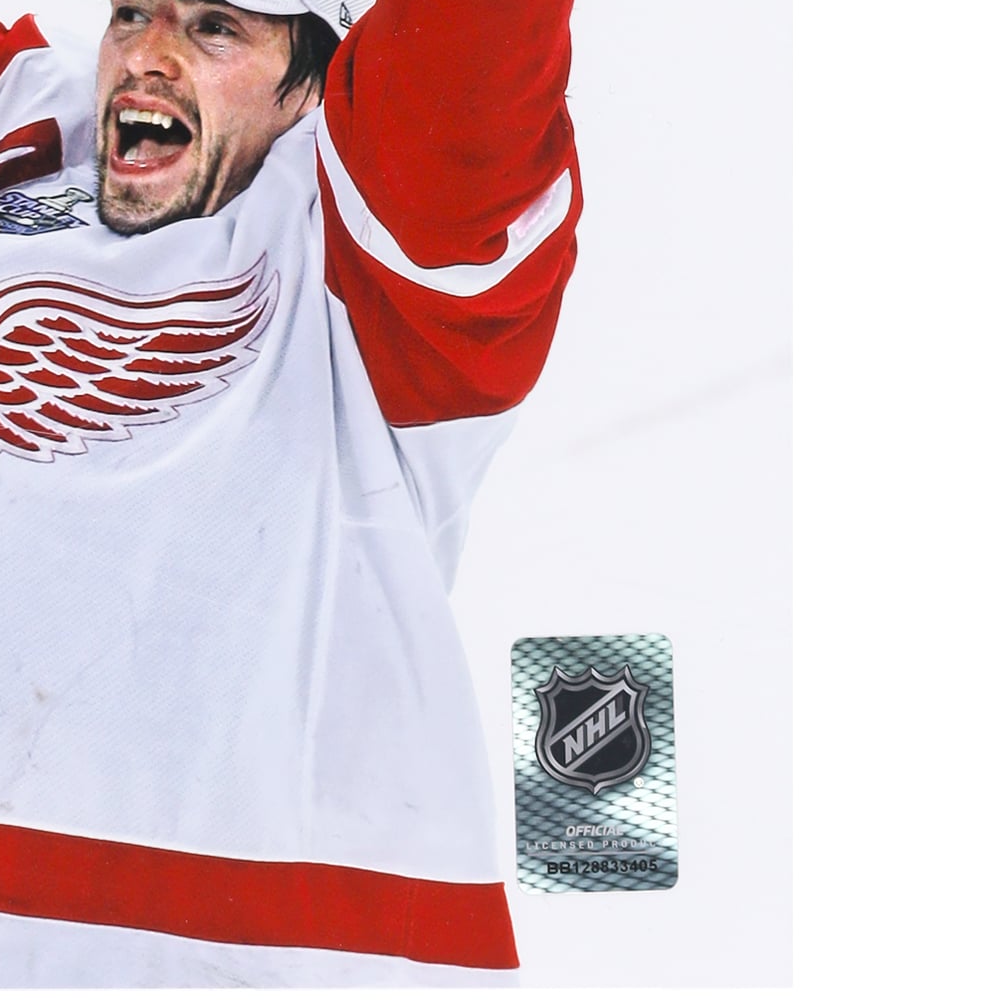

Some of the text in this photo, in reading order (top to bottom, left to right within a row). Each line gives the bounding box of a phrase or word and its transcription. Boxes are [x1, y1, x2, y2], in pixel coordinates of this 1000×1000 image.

[562, 700, 626, 764] NHL
[565, 825, 624, 838] OFFICIAL
[526, 839, 658, 850] LICENSED PRODUC
[546, 859, 658, 875] BB128833405
